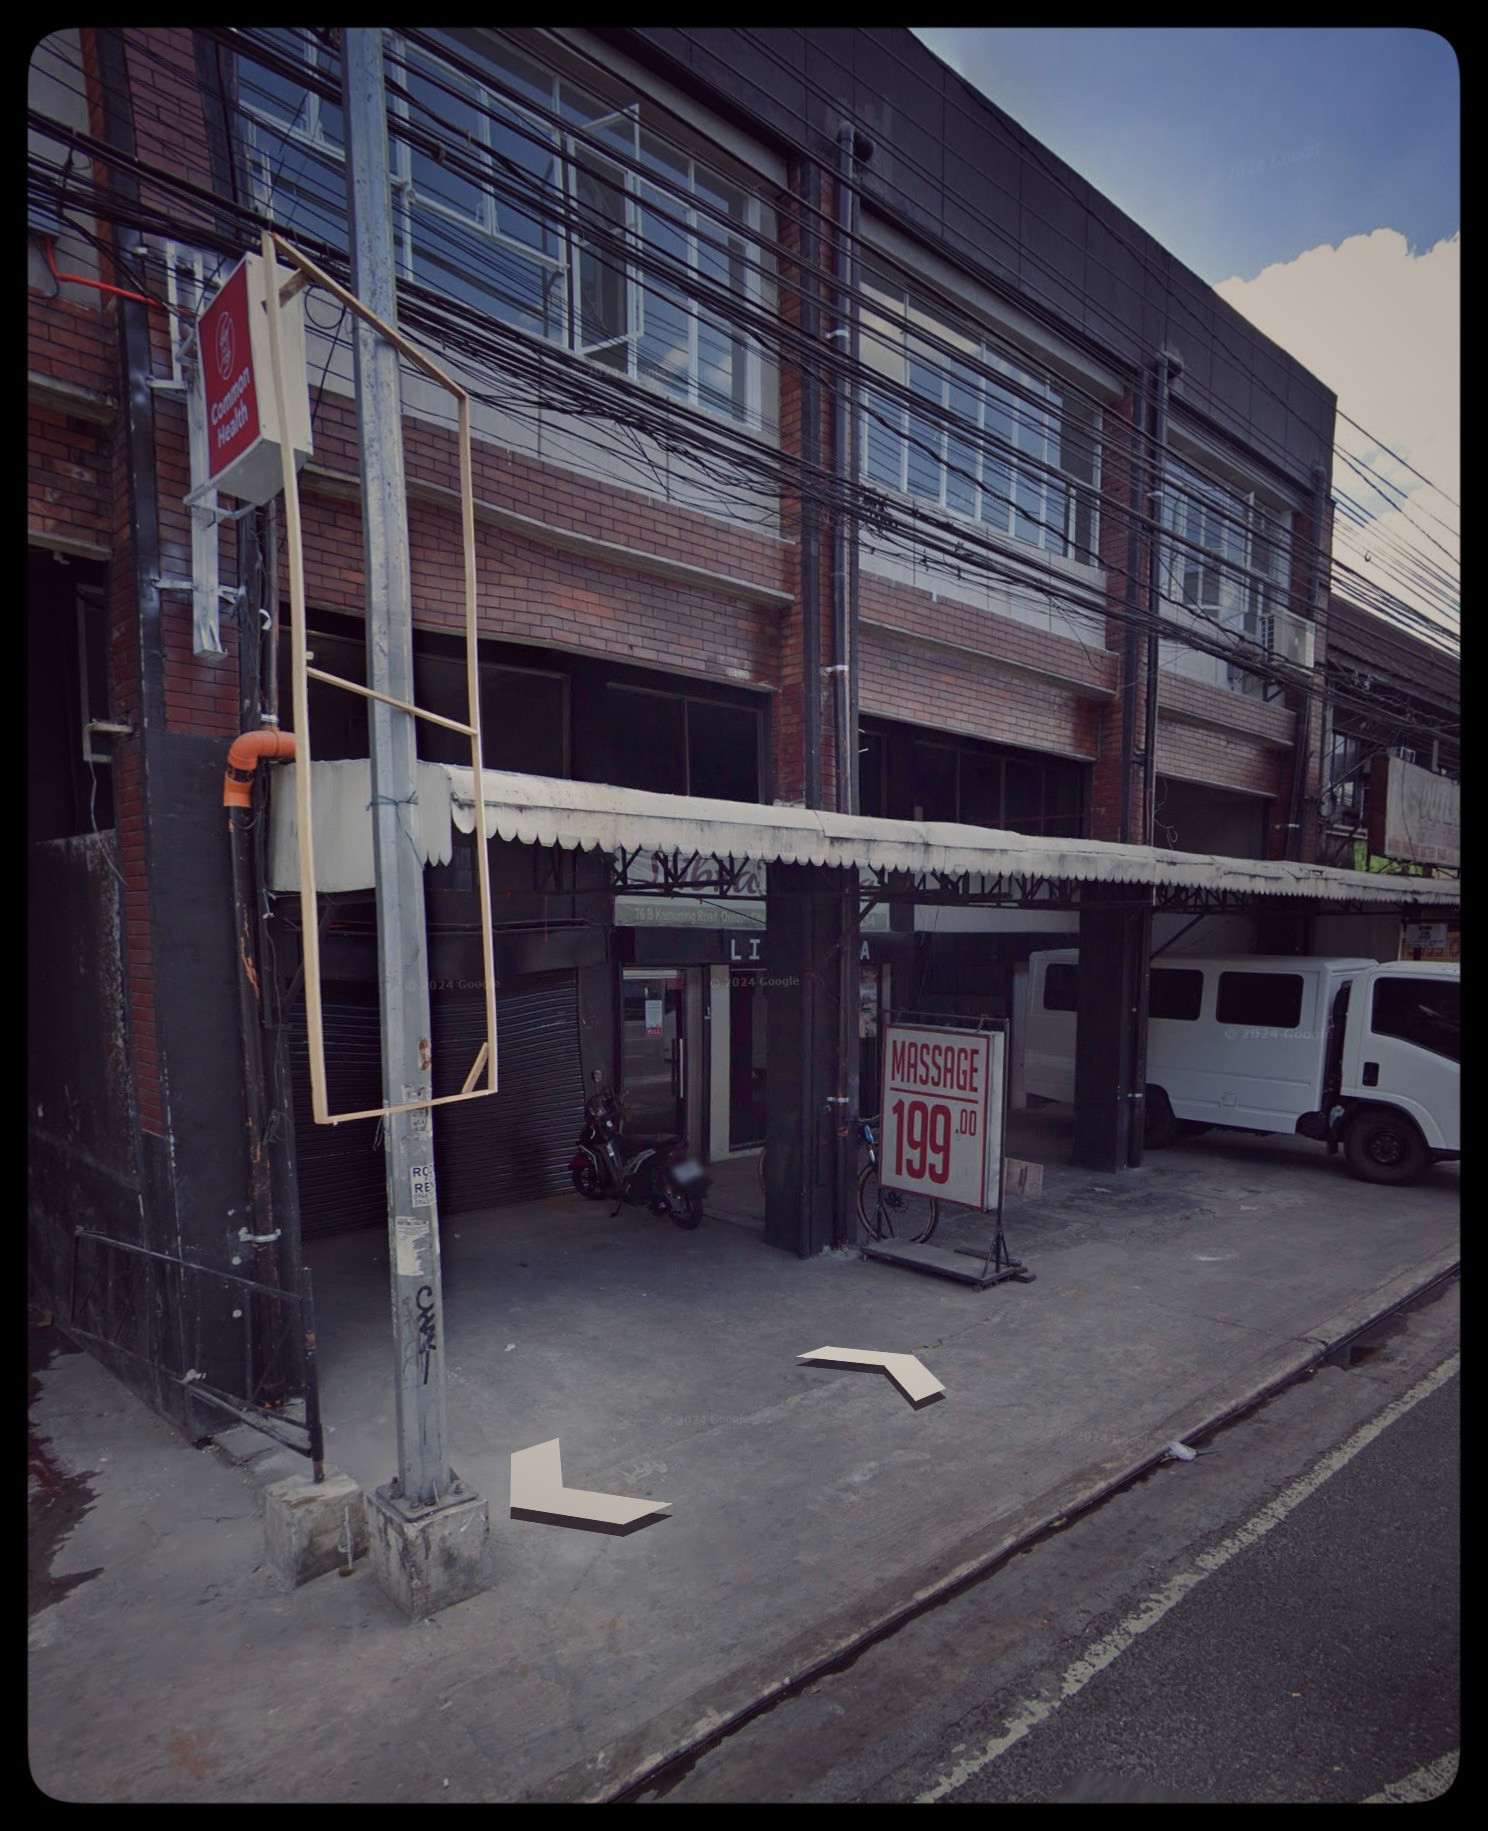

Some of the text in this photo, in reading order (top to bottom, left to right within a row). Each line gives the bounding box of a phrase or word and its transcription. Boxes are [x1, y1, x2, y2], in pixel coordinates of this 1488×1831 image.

[211, 366, 250, 426] Common
[217, 399, 249, 449] Health
[891, 1040, 979, 1093] MASSAGE
